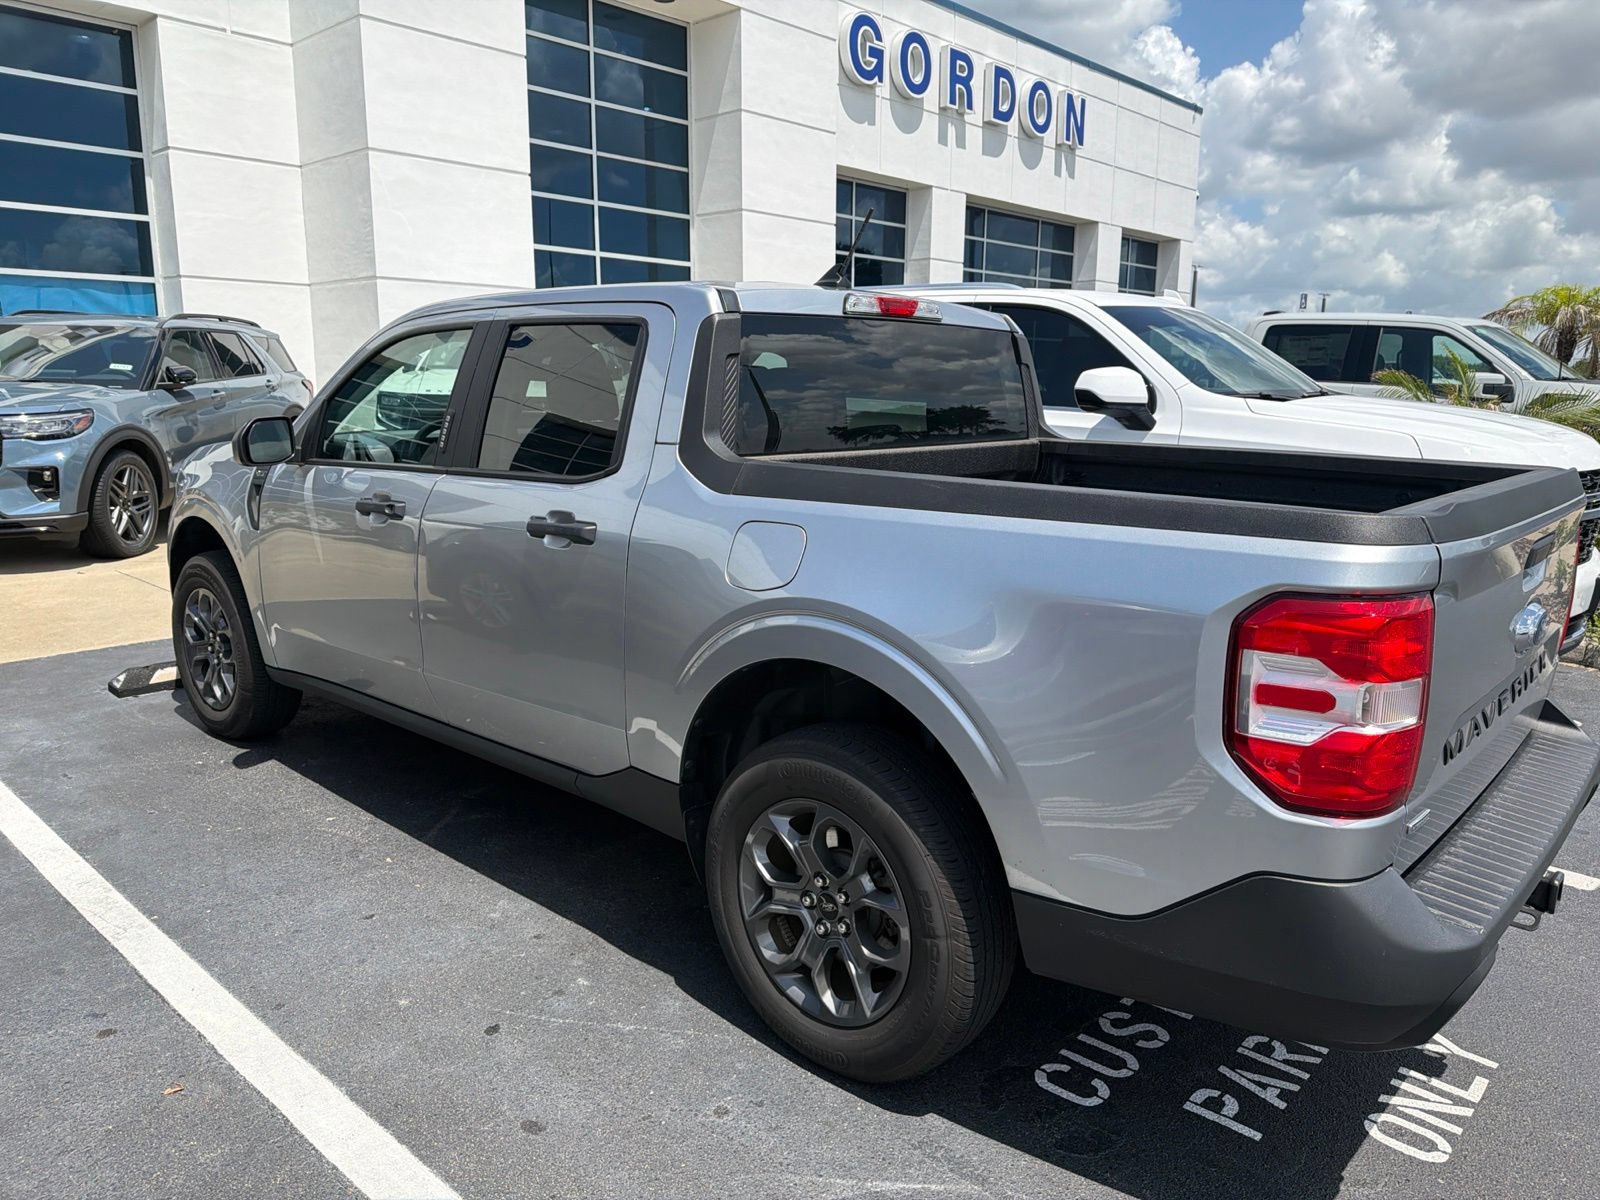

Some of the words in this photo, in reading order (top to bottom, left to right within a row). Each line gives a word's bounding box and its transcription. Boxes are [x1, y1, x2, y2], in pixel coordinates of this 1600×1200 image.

[839, 11, 1087, 149] GORDON
[1443, 650, 1547, 766] MAVERICK
[1183, 1035, 1330, 1151] PAR
[1364, 1033, 1499, 1163] ONLY
